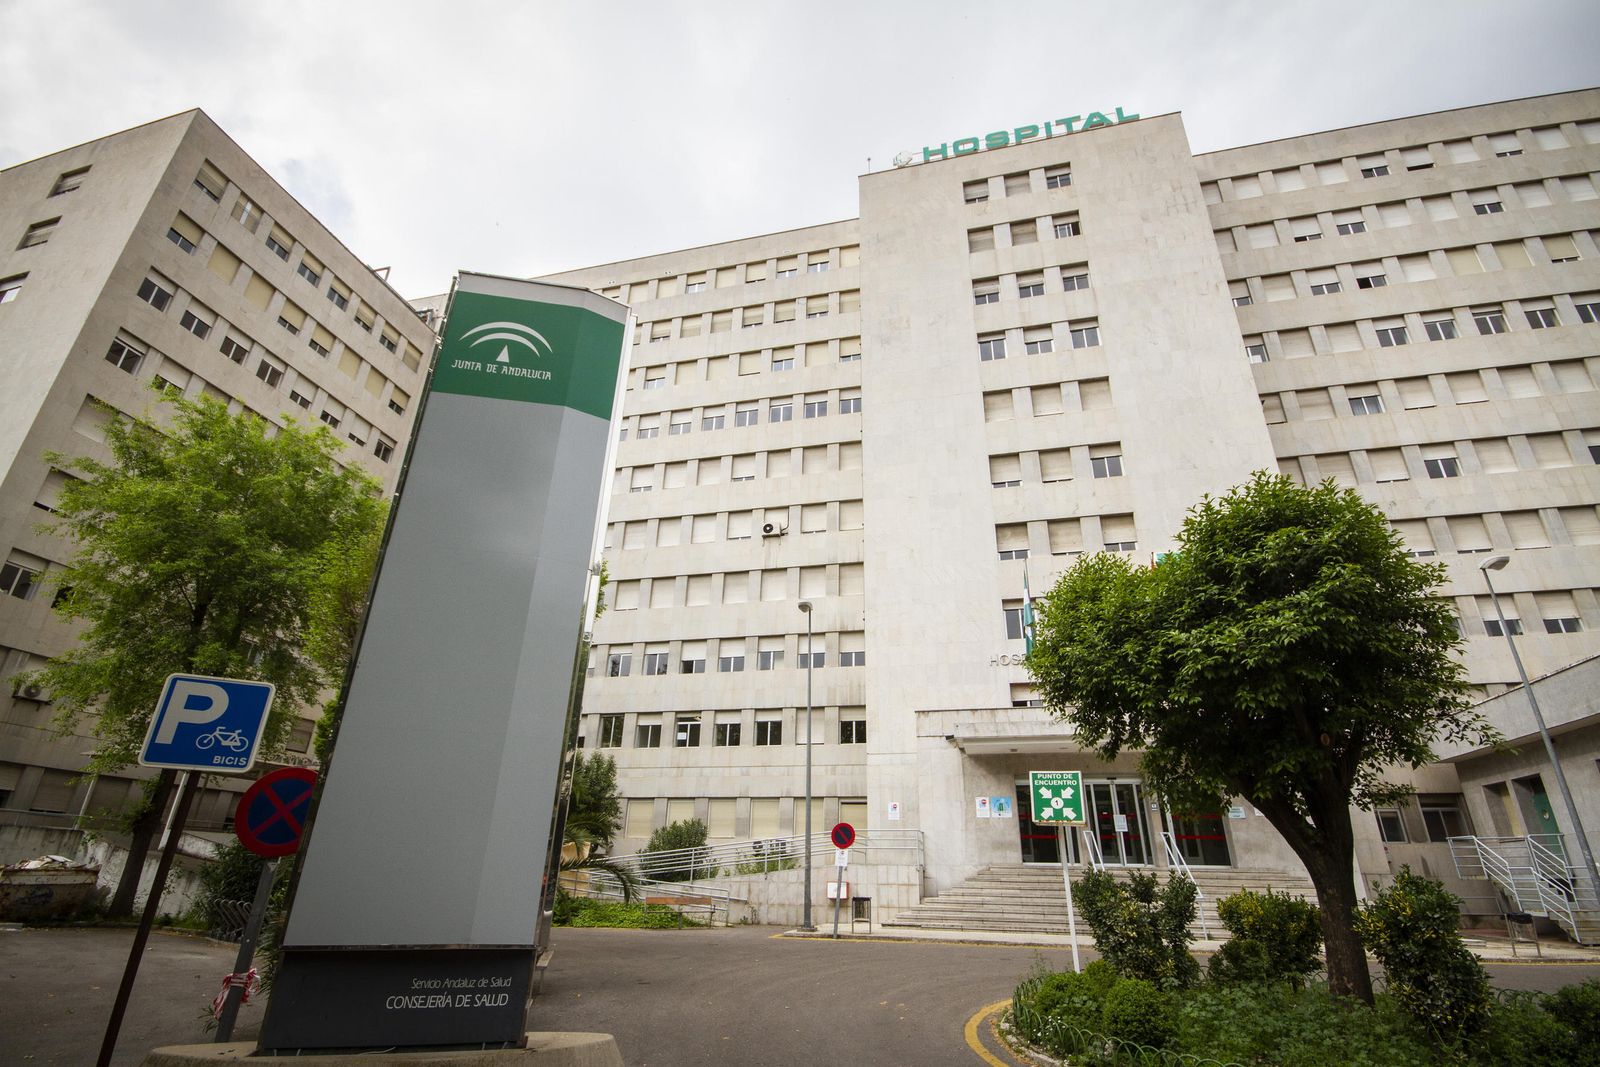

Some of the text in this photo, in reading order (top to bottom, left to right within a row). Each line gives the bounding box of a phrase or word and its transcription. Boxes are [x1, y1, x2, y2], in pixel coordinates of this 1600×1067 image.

[922, 106, 1140, 163] HOSPITAL
[451, 359, 552, 381] JUNTA DE ANDALUCIA
[154, 680, 230, 745] P
[212, 755, 248, 766] BICIS
[411, 976, 512, 990] Servicio Andaluz de Salud
[386, 991, 509, 1009] CONSEJERÍA DE SALUD
